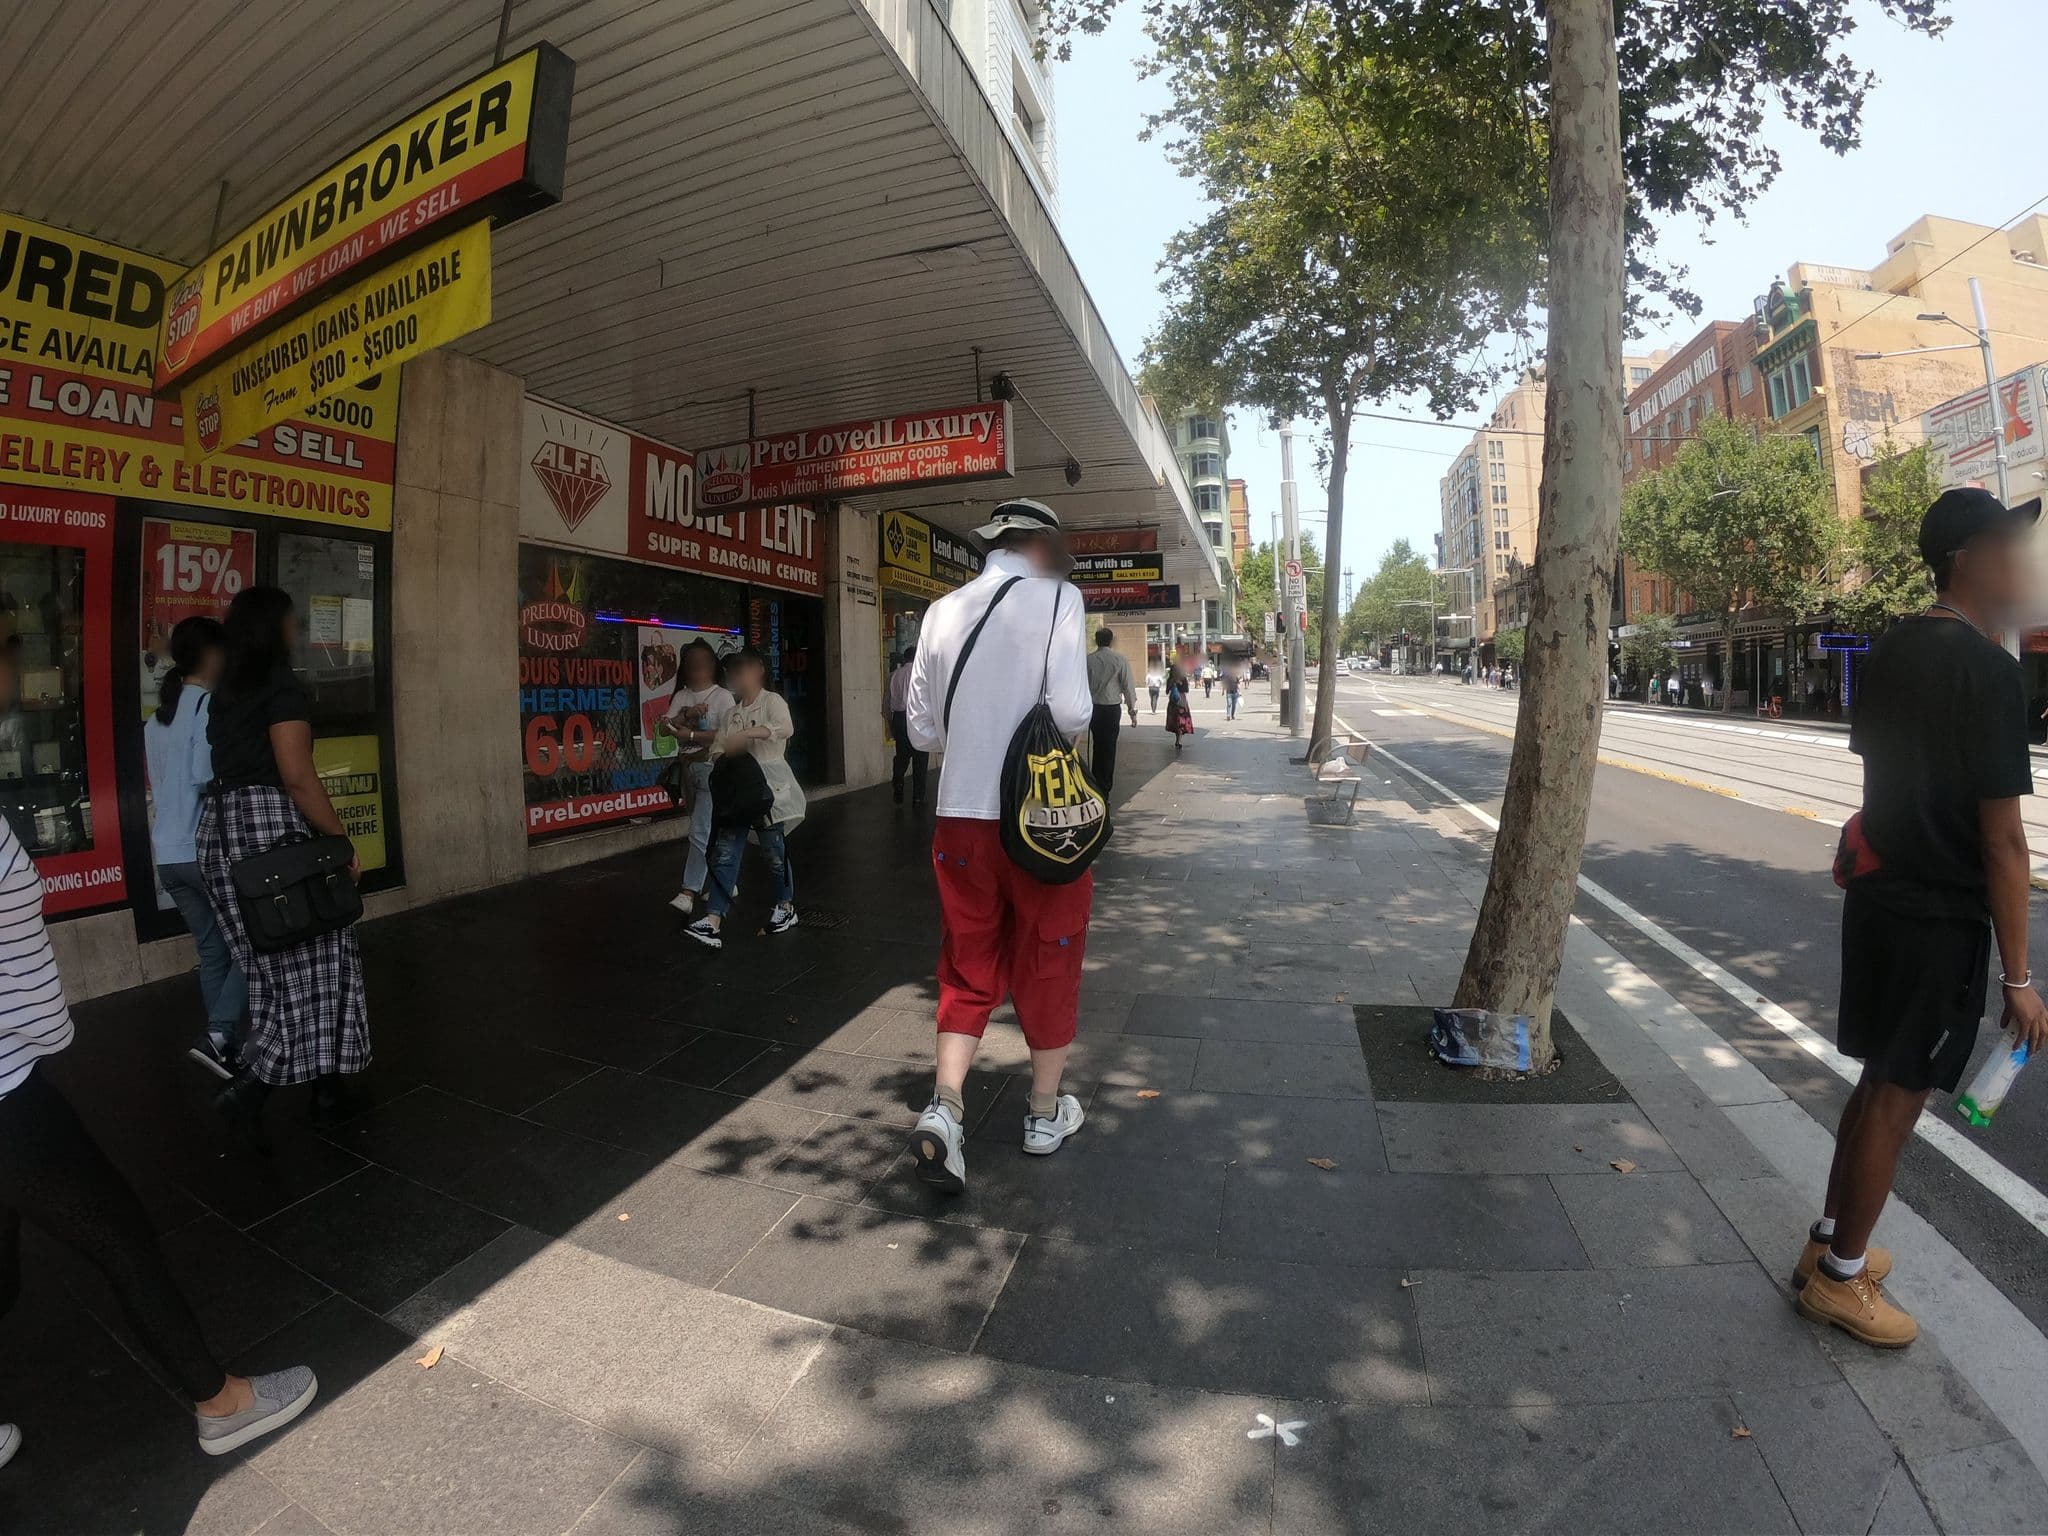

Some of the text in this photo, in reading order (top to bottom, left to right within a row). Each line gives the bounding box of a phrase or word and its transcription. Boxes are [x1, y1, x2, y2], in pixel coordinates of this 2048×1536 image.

[214, 80, 512, 306] PAWNBROKER
[231, 305, 251, 334] WE
[253, 286, 282, 320] BUY
[293, 263, 317, 295] WE
[320, 235, 364, 276] LOAN
[380, 209, 410, 243] WE
[415, 183, 460, 225] SELL
[167, 305, 198, 348] STOP
[232, 249, 461, 396] UNSECURED LOANS AVAILABLE
[309, 350, 346, 397] $300
[363, 314, 418, 370] $5000
[1694, 346, 1718, 385] HOTEL
[28, 375, 154, 428] LOAN
[273, 424, 364, 470] SELL
[199, 412, 219, 438] STOP
[751, 410, 996, 467] PreLovedLuxury
[534, 445, 606, 479] ALFA
[751, 485, 778, 501] Louis
[964, 456, 997, 473] Rolex
[795, 444, 949, 477] AUTHENTIC LUXURY GOODS
[139, 455, 162, 488] &
[173, 459, 371, 518] ELECTRONICS
[11, 503, 61, 524] LUXURY
[64, 510, 106, 528] GOODS
[760, 505, 817, 560] LENT
[157, 543, 242, 594] 15%
[648, 532, 818, 586] SUPER BARGAIN CENTRE
[522, 602, 586, 629] PRELOVED
[527, 627, 582, 651] LUXURY
[566, 657, 634, 687] VUITTON
[519, 687, 630, 713] HERMES
[347, 820, 378, 836] HERE
[84, 865, 122, 887] LOANS
